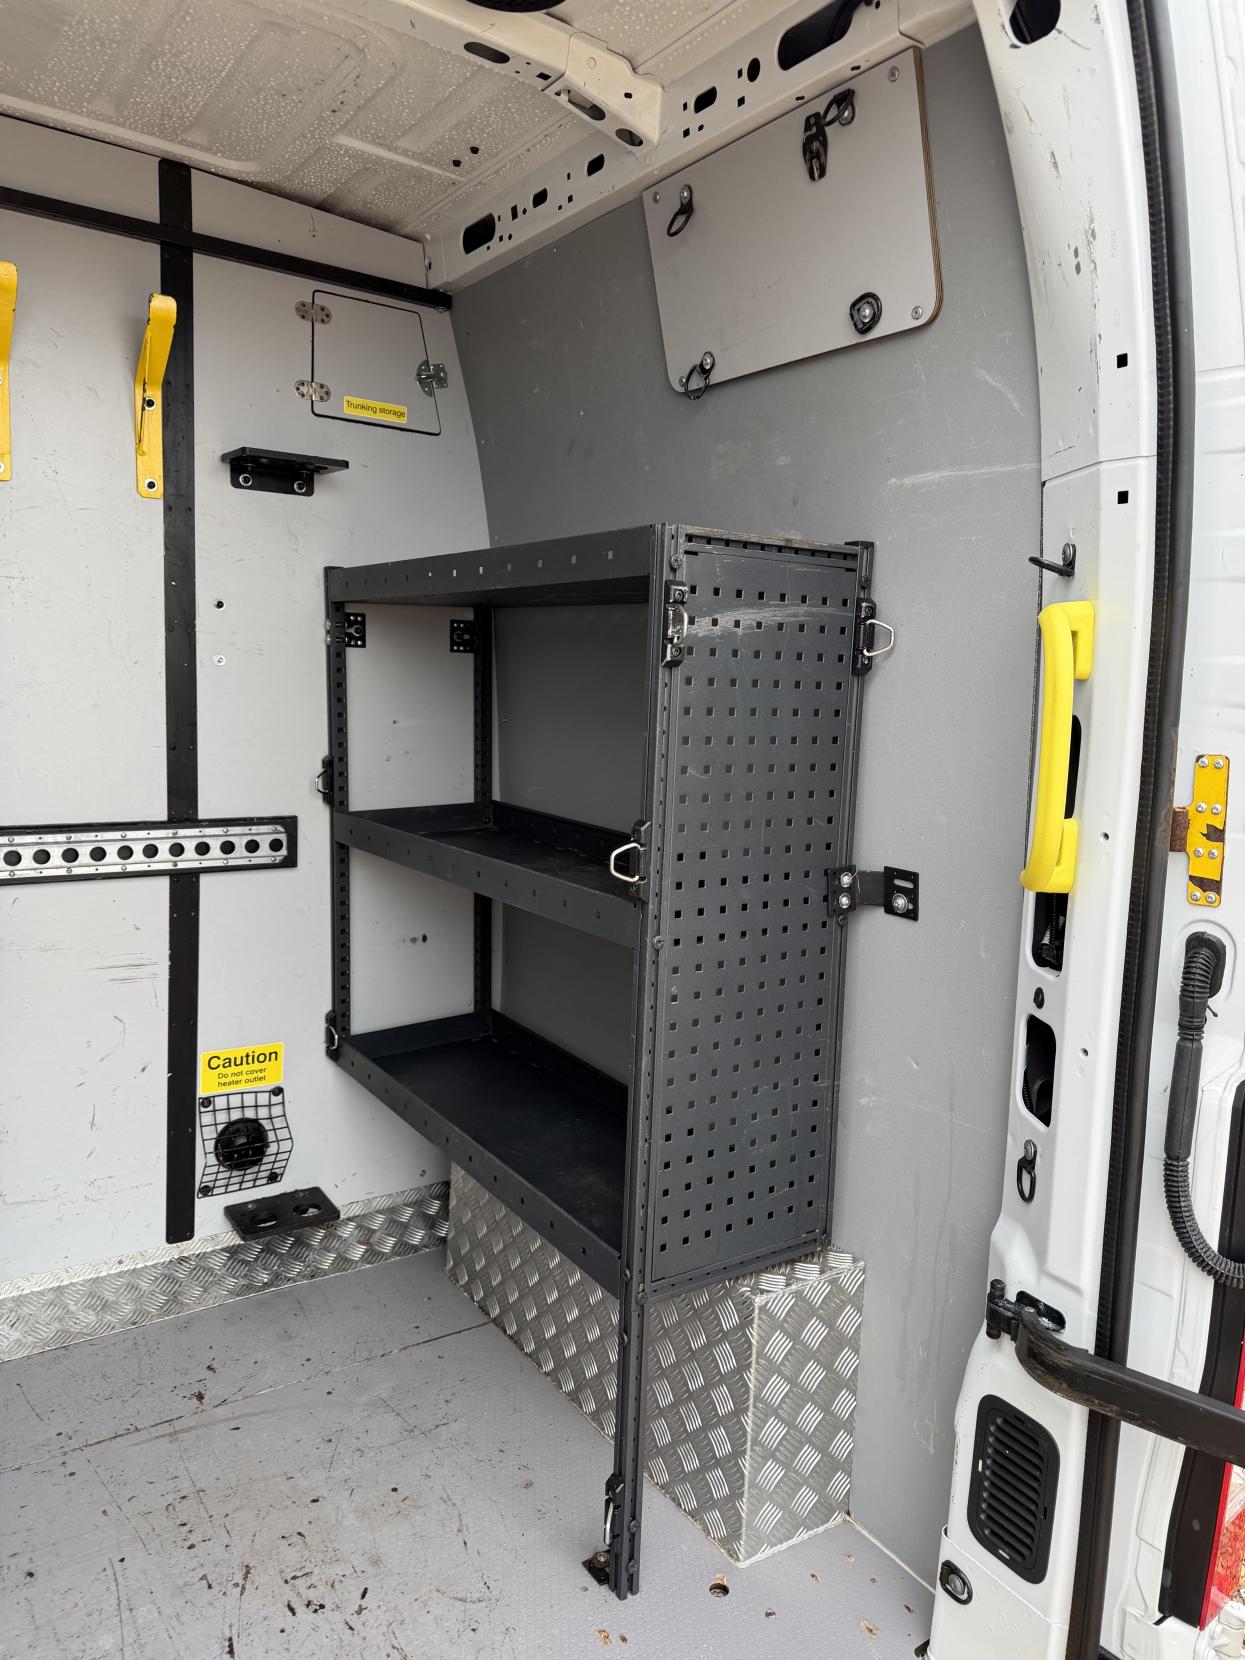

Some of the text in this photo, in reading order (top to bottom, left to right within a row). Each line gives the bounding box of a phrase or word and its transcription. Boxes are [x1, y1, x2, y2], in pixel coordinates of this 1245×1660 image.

[346, 400, 406, 418] Trunking storage
[208, 1051, 278, 1070] Caution
[246, 1067, 267, 1075] cover
[217, 1075, 266, 1087] heater outlet
